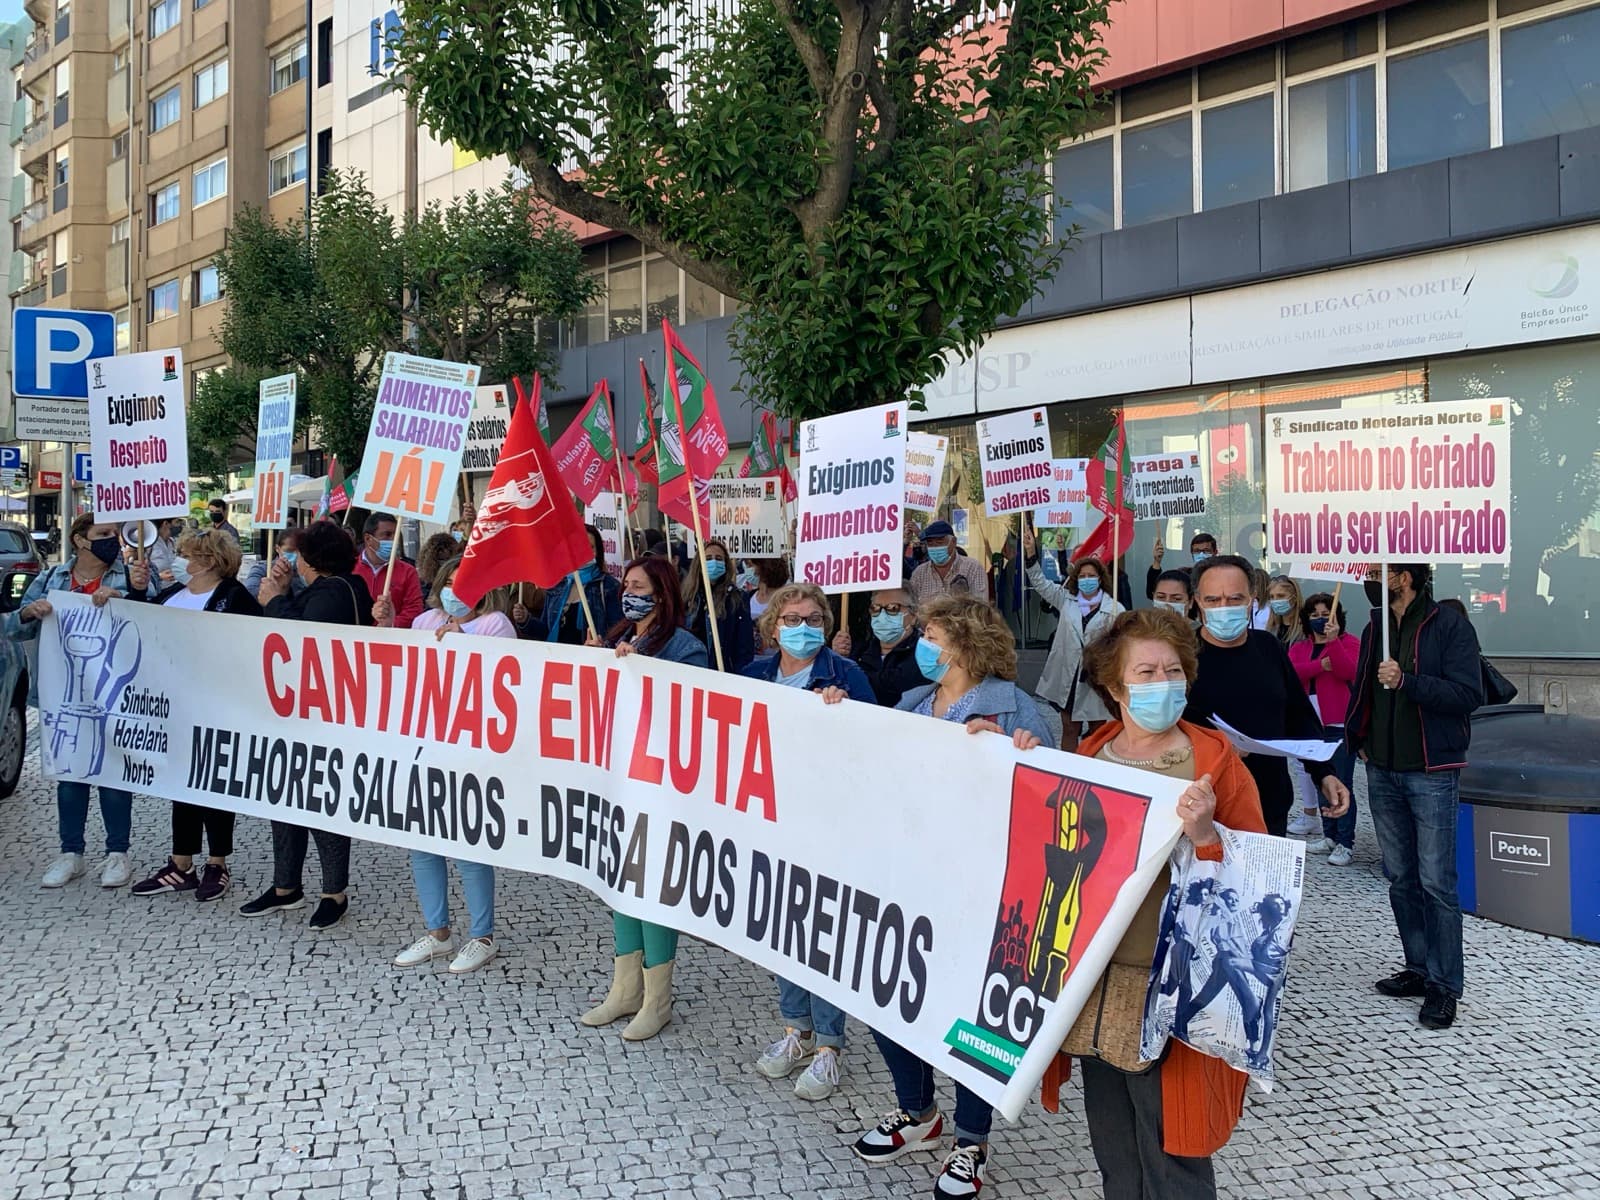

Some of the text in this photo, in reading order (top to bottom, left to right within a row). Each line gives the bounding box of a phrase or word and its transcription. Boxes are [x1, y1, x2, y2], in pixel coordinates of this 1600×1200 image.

[1279, 276, 1463, 320] DELEGAÇÃO NORTE
[1520, 303, 1588, 320] Balcão Único
[1294, 322, 1364, 344] SIMILARES
[1388, 307, 1463, 331] PORTUGAL
[36, 317, 94, 390] P
[31, 404, 60, 413] Portador
[107, 393, 166, 427] Exigimos
[379, 376, 472, 419] AUMENTOS
[18, 416, 70, 425] estacionamento
[375, 410, 463, 452] SALARIAIS
[476, 414, 507, 440] salários
[1289, 411, 1482, 434] Sindicato Hotelaria Norte
[109, 435, 167, 468] Respeito
[986, 436, 1044, 462] Exigimos
[1280, 433, 1496, 494] Trabalho no feriado
[364, 447, 445, 516] JÁ!
[727, 484, 741, 499] Mário
[742, 483, 761, 498] Pereira
[808, 456, 895, 496] Exigimos
[905, 472, 931, 487] espeito
[986, 461, 1051, 488] Aumentos
[1135, 475, 1194, 498] à precaridade
[96, 477, 186, 513] Pelos Direitos
[254, 462, 285, 523] JÁ!
[909, 491, 936, 508] Direitos
[992, 487, 1050, 513] salariais
[1067, 488, 1085, 503] horas
[1150, 499, 1161, 517] de
[1162, 495, 1205, 518] qualidade
[593, 513, 616, 532] Exigimos
[716, 500, 750, 526] Não aos
[800, 504, 899, 543] Aumentos
[1273, 499, 1507, 555] tem de ser valorizado
[729, 530, 740, 553] de
[742, 529, 774, 554] Miséria
[804, 549, 891, 587] salariais
[120, 685, 170, 719] Sindicato
[114, 719, 168, 754] Hotelaria
[262, 632, 778, 823] CANTINAS EM LUTA
[122, 754, 154, 786] Norte
[1498, 840, 1542, 858] Porto.
[187, 725, 344, 818] MELHORES
[350, 746, 506, 851] SALÁRIOS
[540, 784, 649, 899] DEFESA
[659, 820, 738, 928] DOS
[746, 849, 934, 1024] DIREITOS
[957, 1029, 1021, 1069] INTERSINDIC
